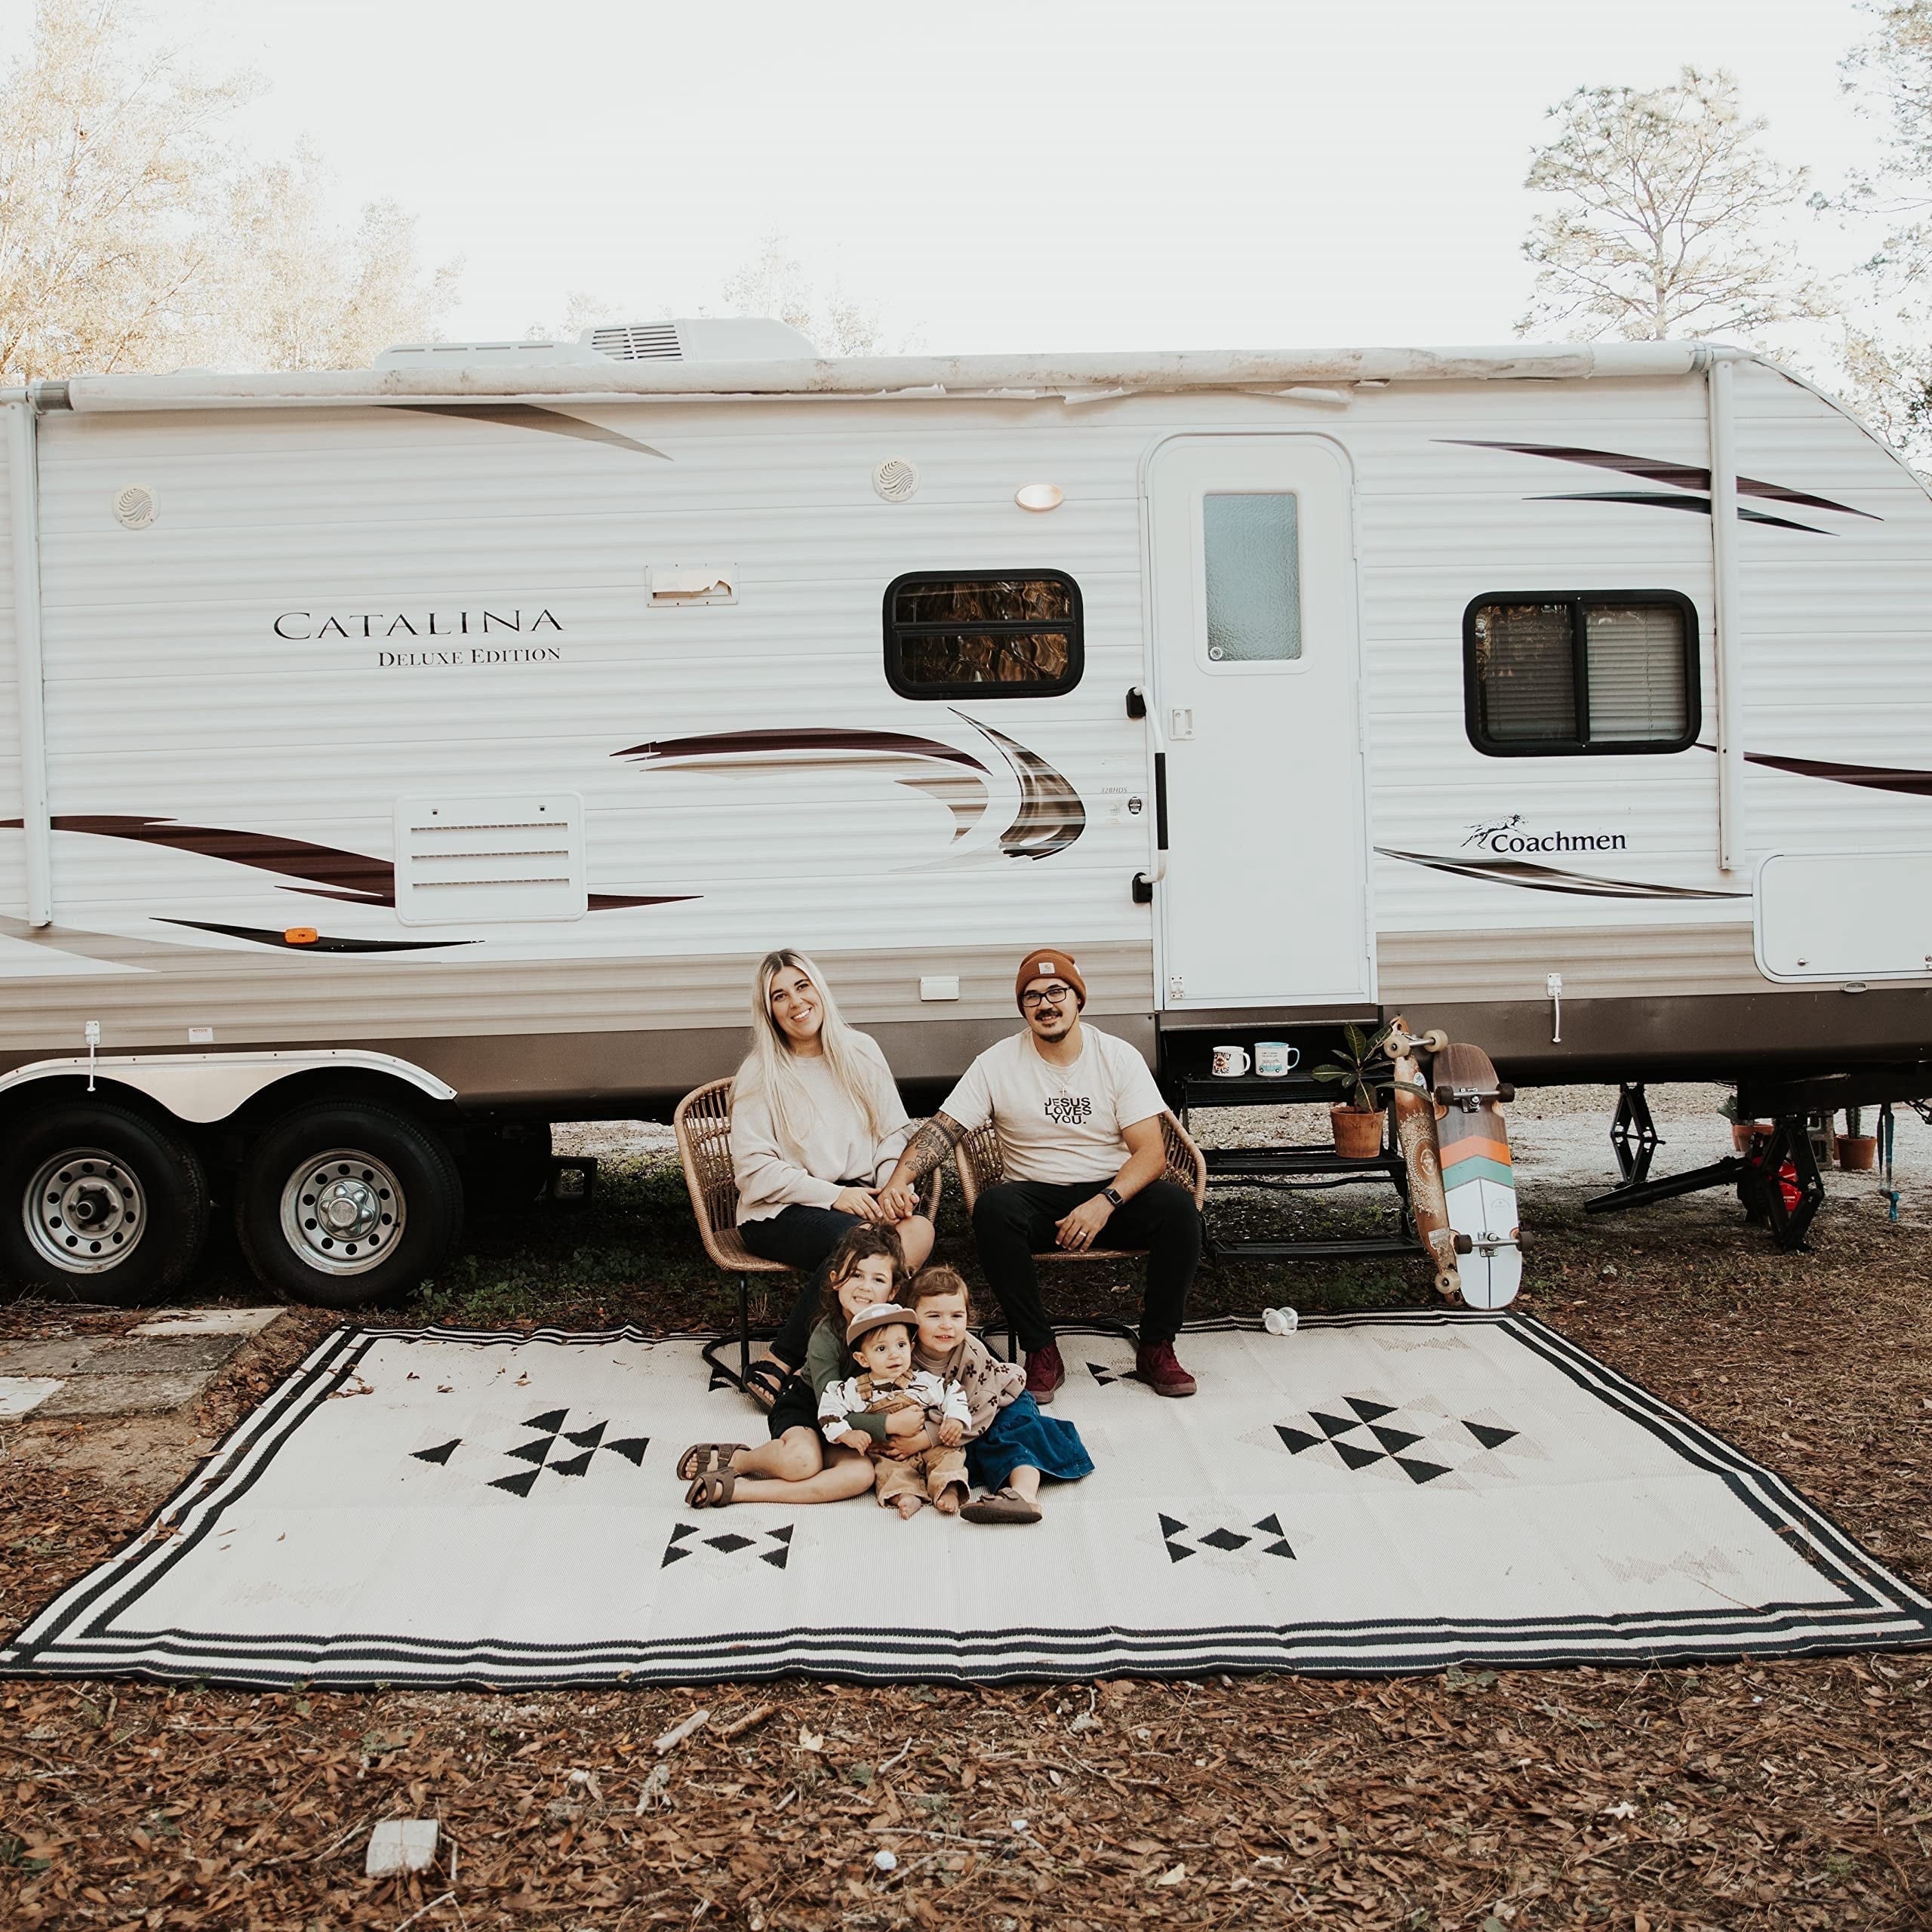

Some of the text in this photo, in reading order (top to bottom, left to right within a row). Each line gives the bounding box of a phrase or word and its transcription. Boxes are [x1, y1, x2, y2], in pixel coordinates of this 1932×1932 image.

[273, 609, 565, 640] CATALINA
[379, 648, 560, 667] DELUXE EDITION
[1491, 831, 1627, 853] Coachmen
[1044, 1097, 1091, 1107] JESUS
[1045, 1106, 1092, 1115] LOVES
[1051, 1115, 1087, 1124] YOU.
